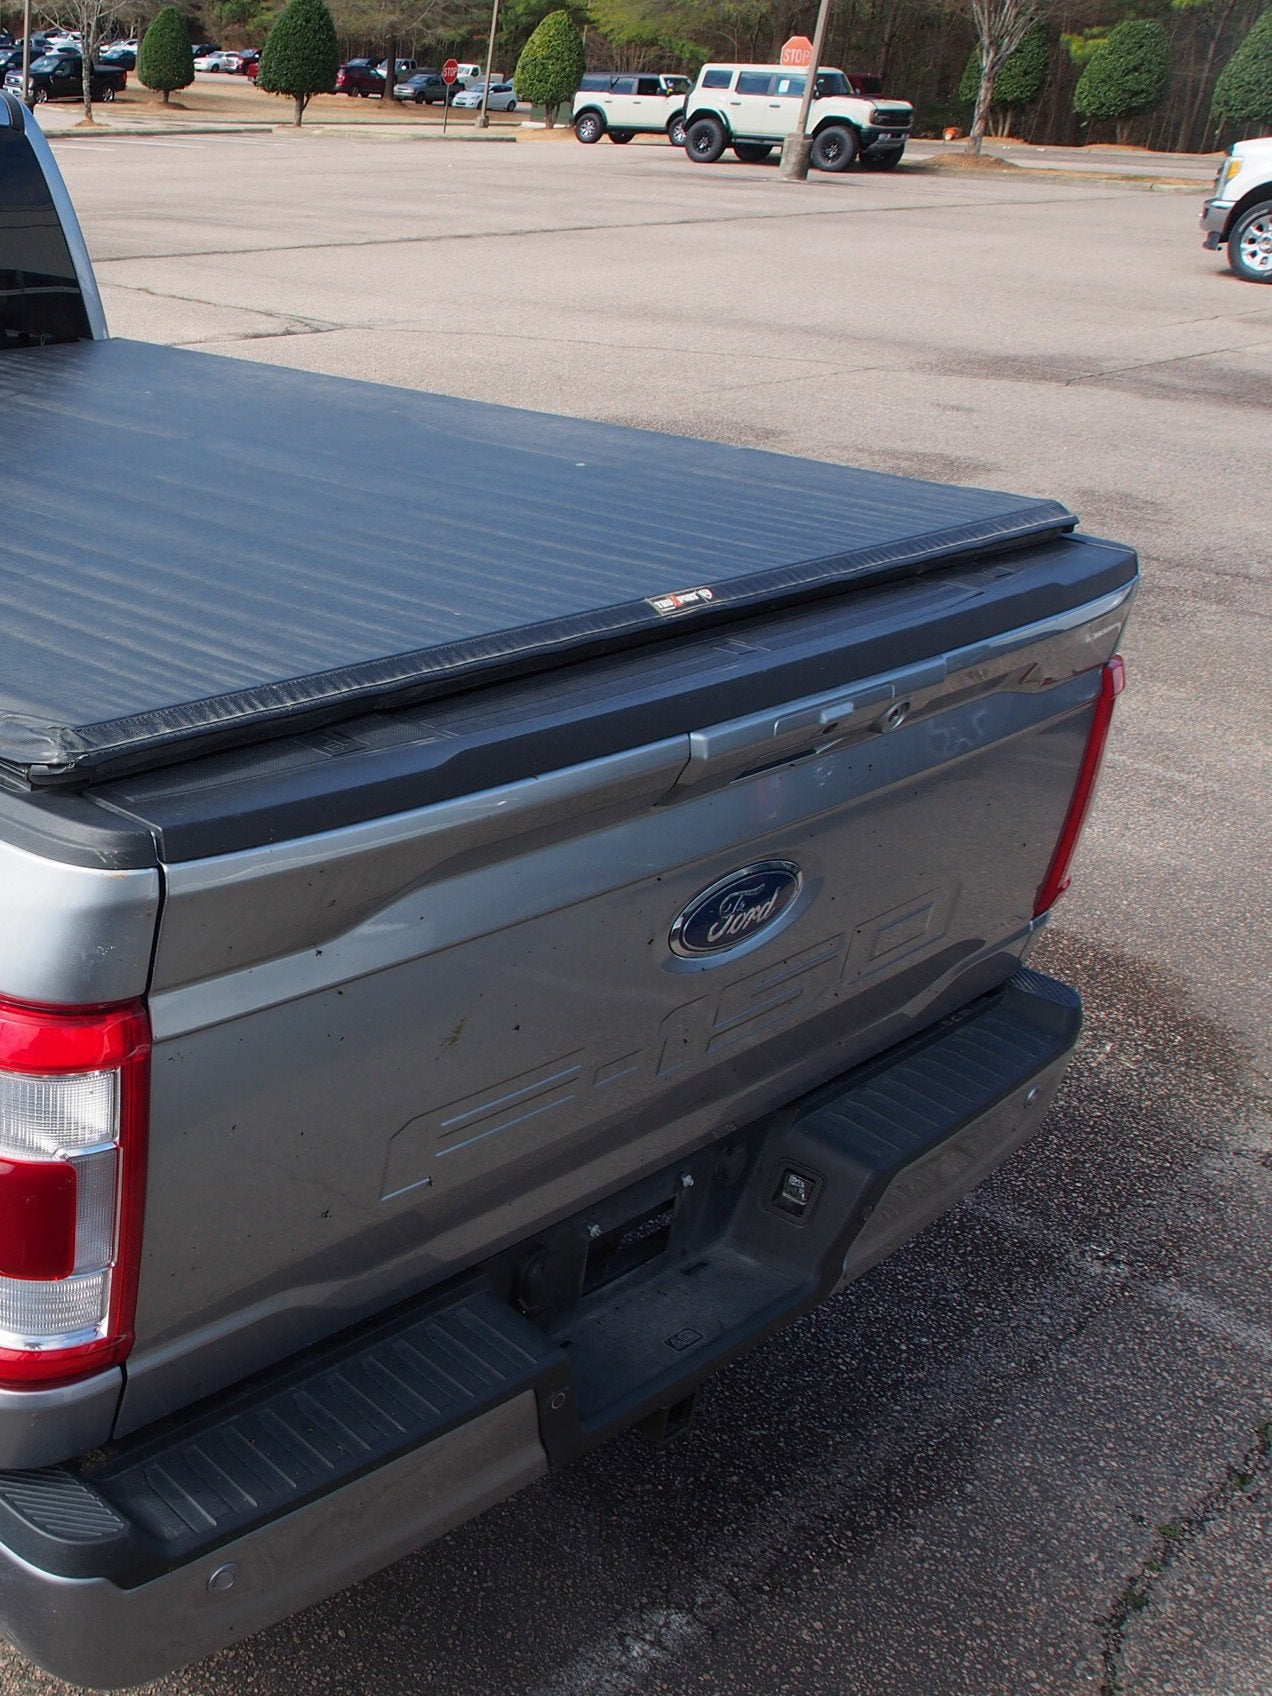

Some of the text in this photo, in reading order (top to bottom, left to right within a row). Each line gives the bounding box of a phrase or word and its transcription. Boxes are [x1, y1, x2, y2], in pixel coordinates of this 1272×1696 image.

[783, 48, 811, 63] STOP
[444, 67, 458, 77] STOP
[707, 883, 781, 943] Ford
